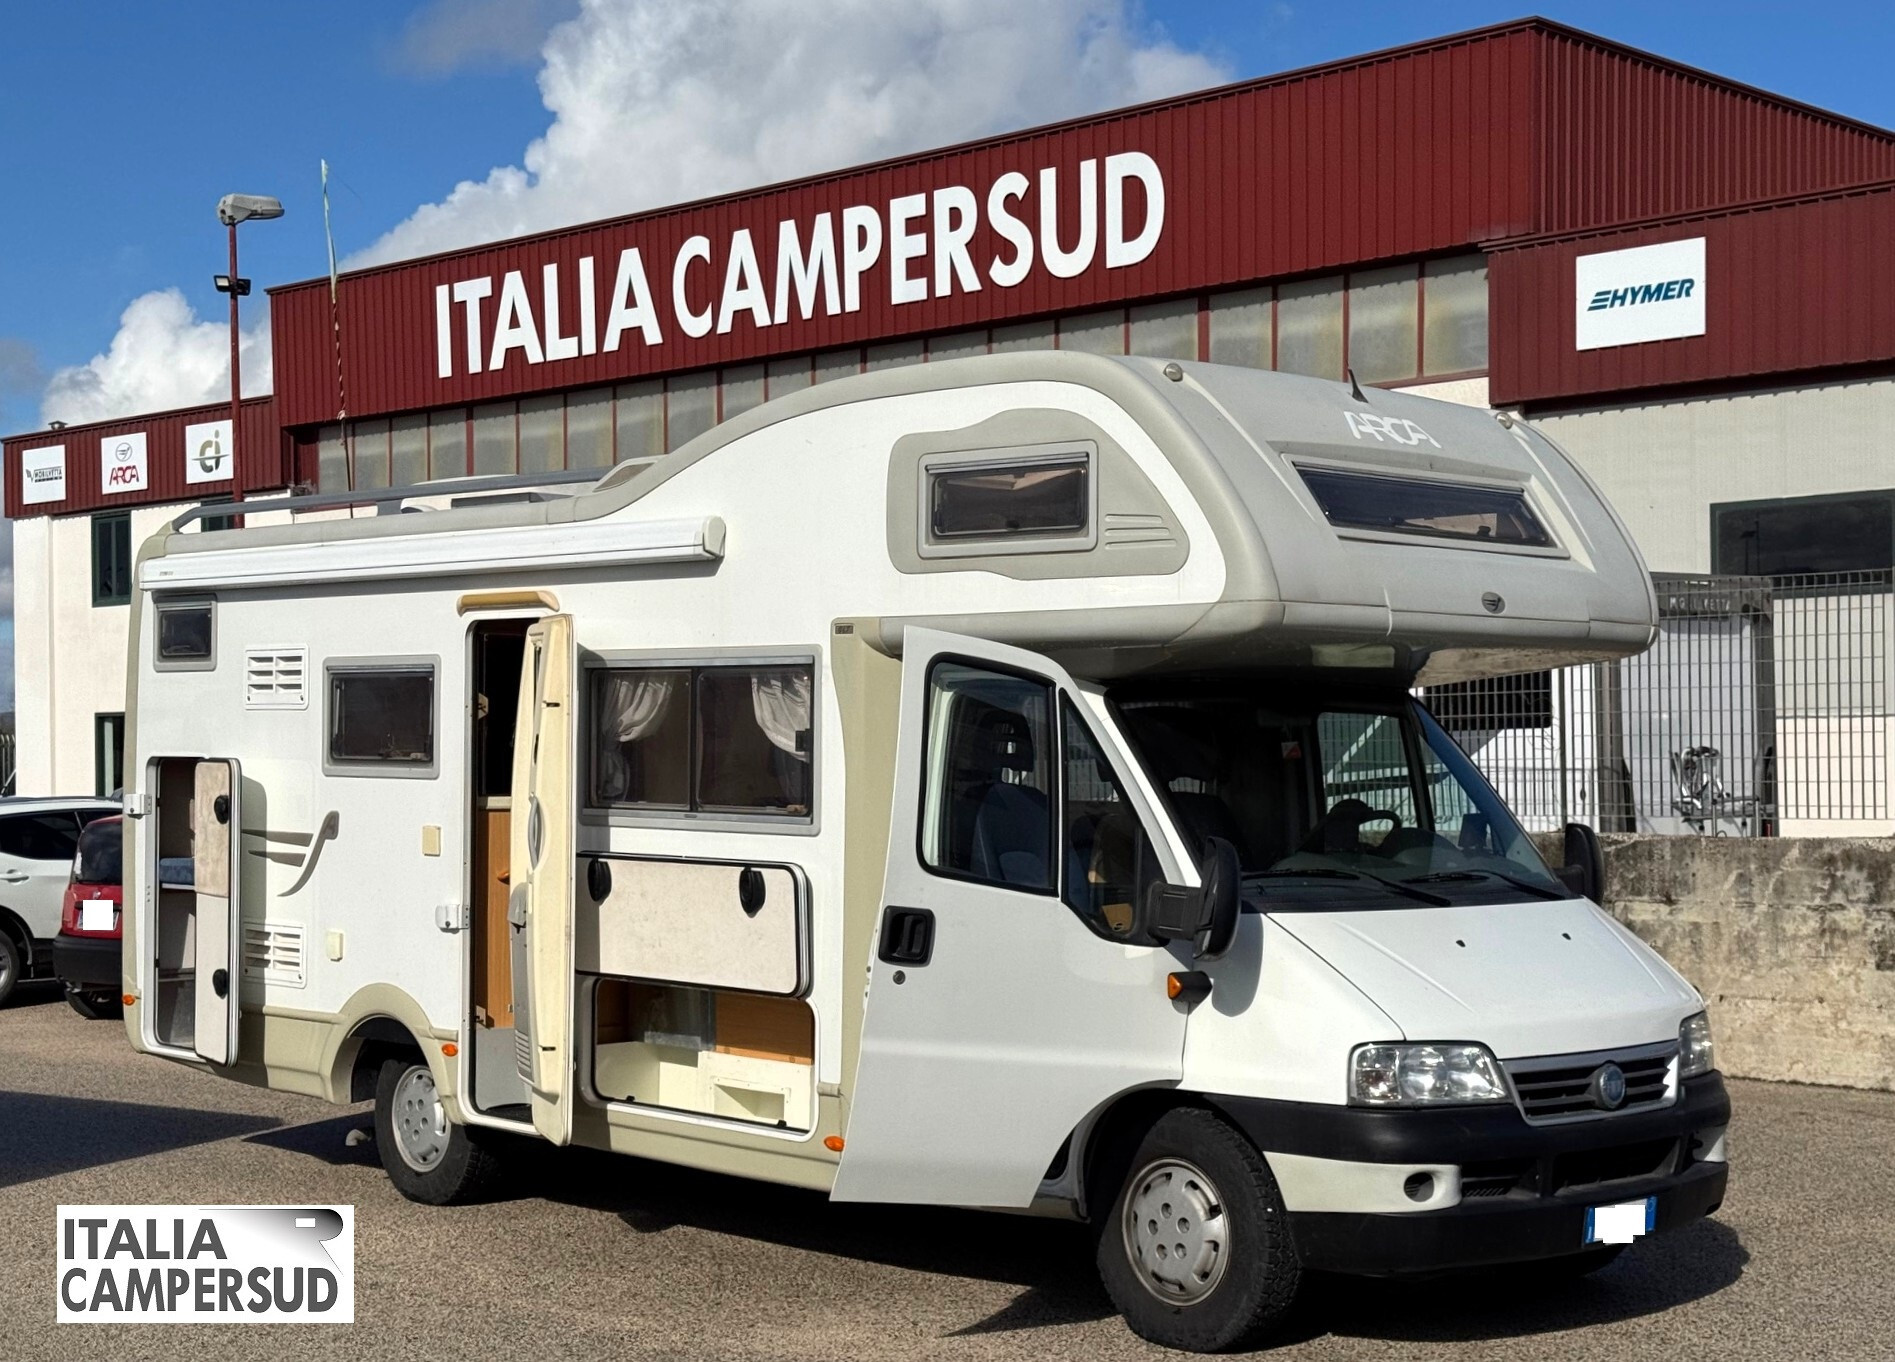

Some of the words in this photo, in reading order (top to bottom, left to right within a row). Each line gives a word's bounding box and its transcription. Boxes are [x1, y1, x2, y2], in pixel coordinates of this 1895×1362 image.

[436, 247, 663, 379] ITALIA
[673, 151, 1165, 339] CAMPERSUD
[1608, 278, 1695, 309] HYMER
[1343, 411, 1442, 449] ARCA
[109, 465, 140, 486] ARCA
